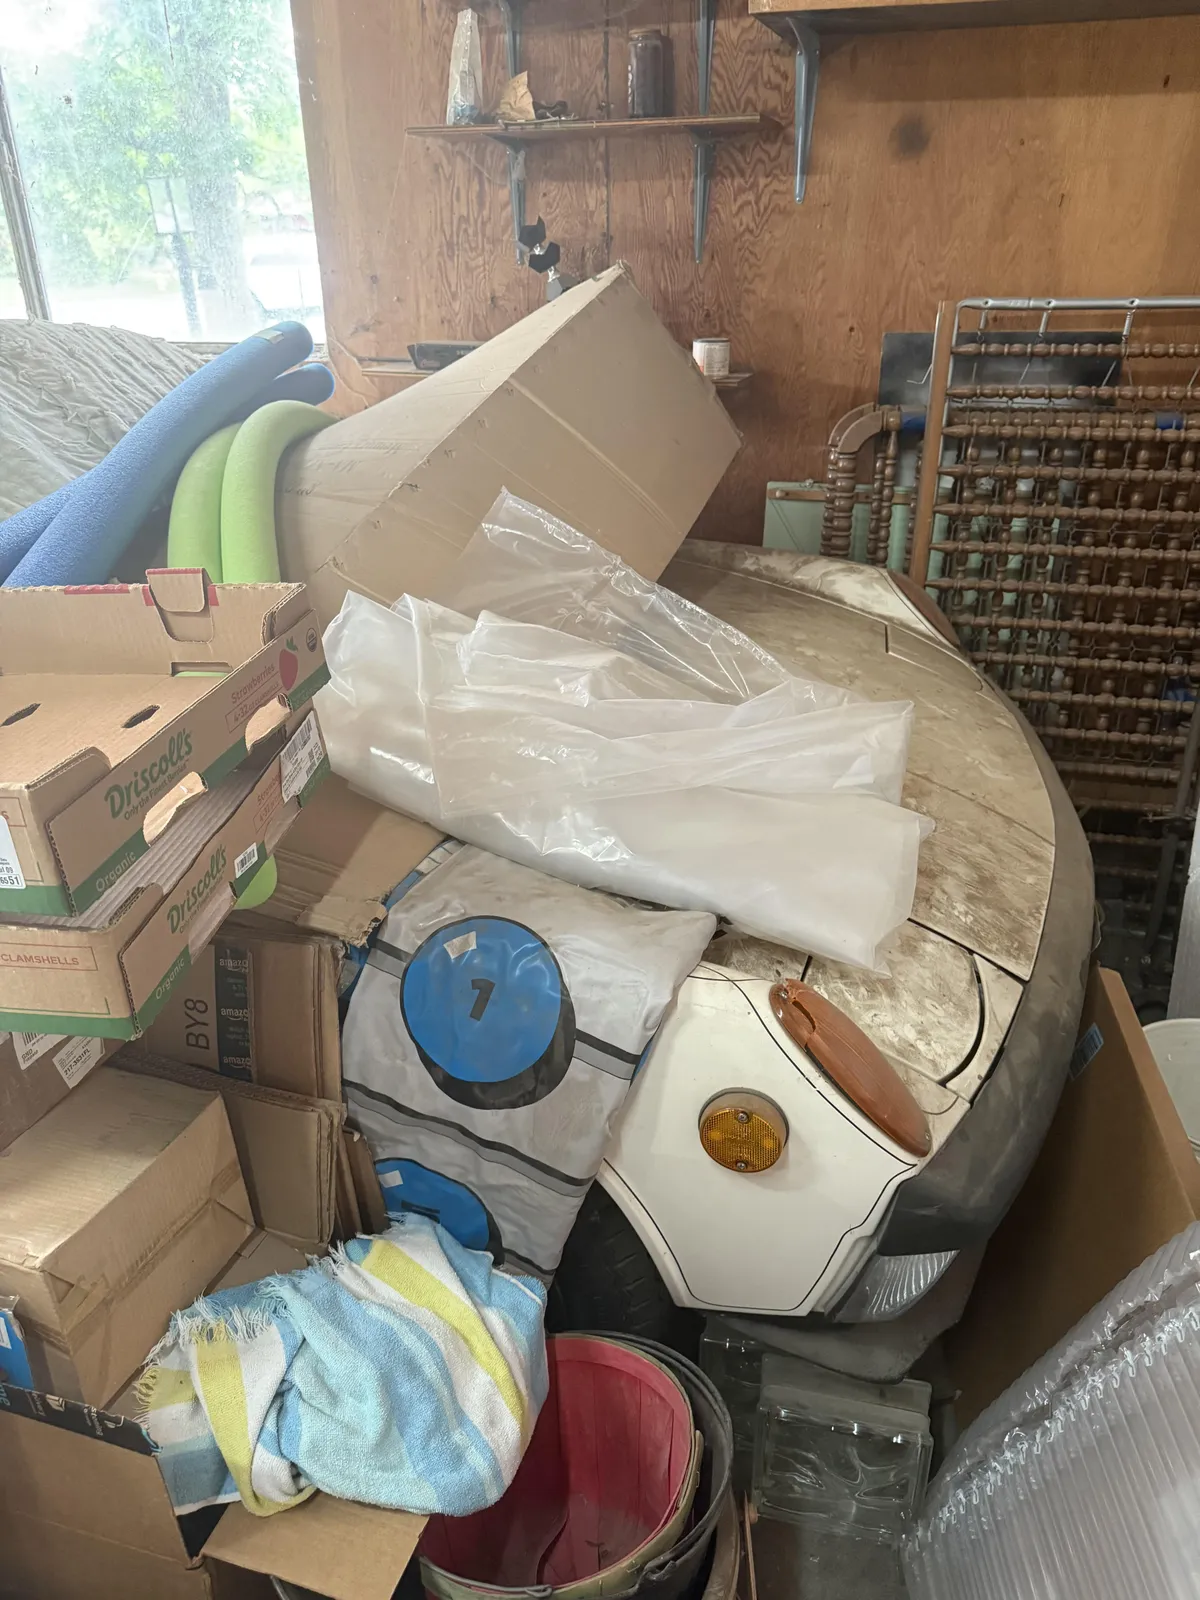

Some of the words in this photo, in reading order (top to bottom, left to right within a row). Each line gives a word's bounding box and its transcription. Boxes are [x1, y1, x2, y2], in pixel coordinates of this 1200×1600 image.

[231, 663, 275, 704] Strawberries
[104, 728, 193, 819] Driscoll's
[124, 804, 139, 820] Only
[95, 851, 136, 892] Organic
[167, 843, 227, 934] Driscoll's
[0, 953, 80, 966] CLAMSHELLS
[155, 957, 185, 1000] Organic
[219, 959, 249, 970] amazo
[184, 998, 210, 1050] BY8
[220, 1008, 250, 1020] amazo
